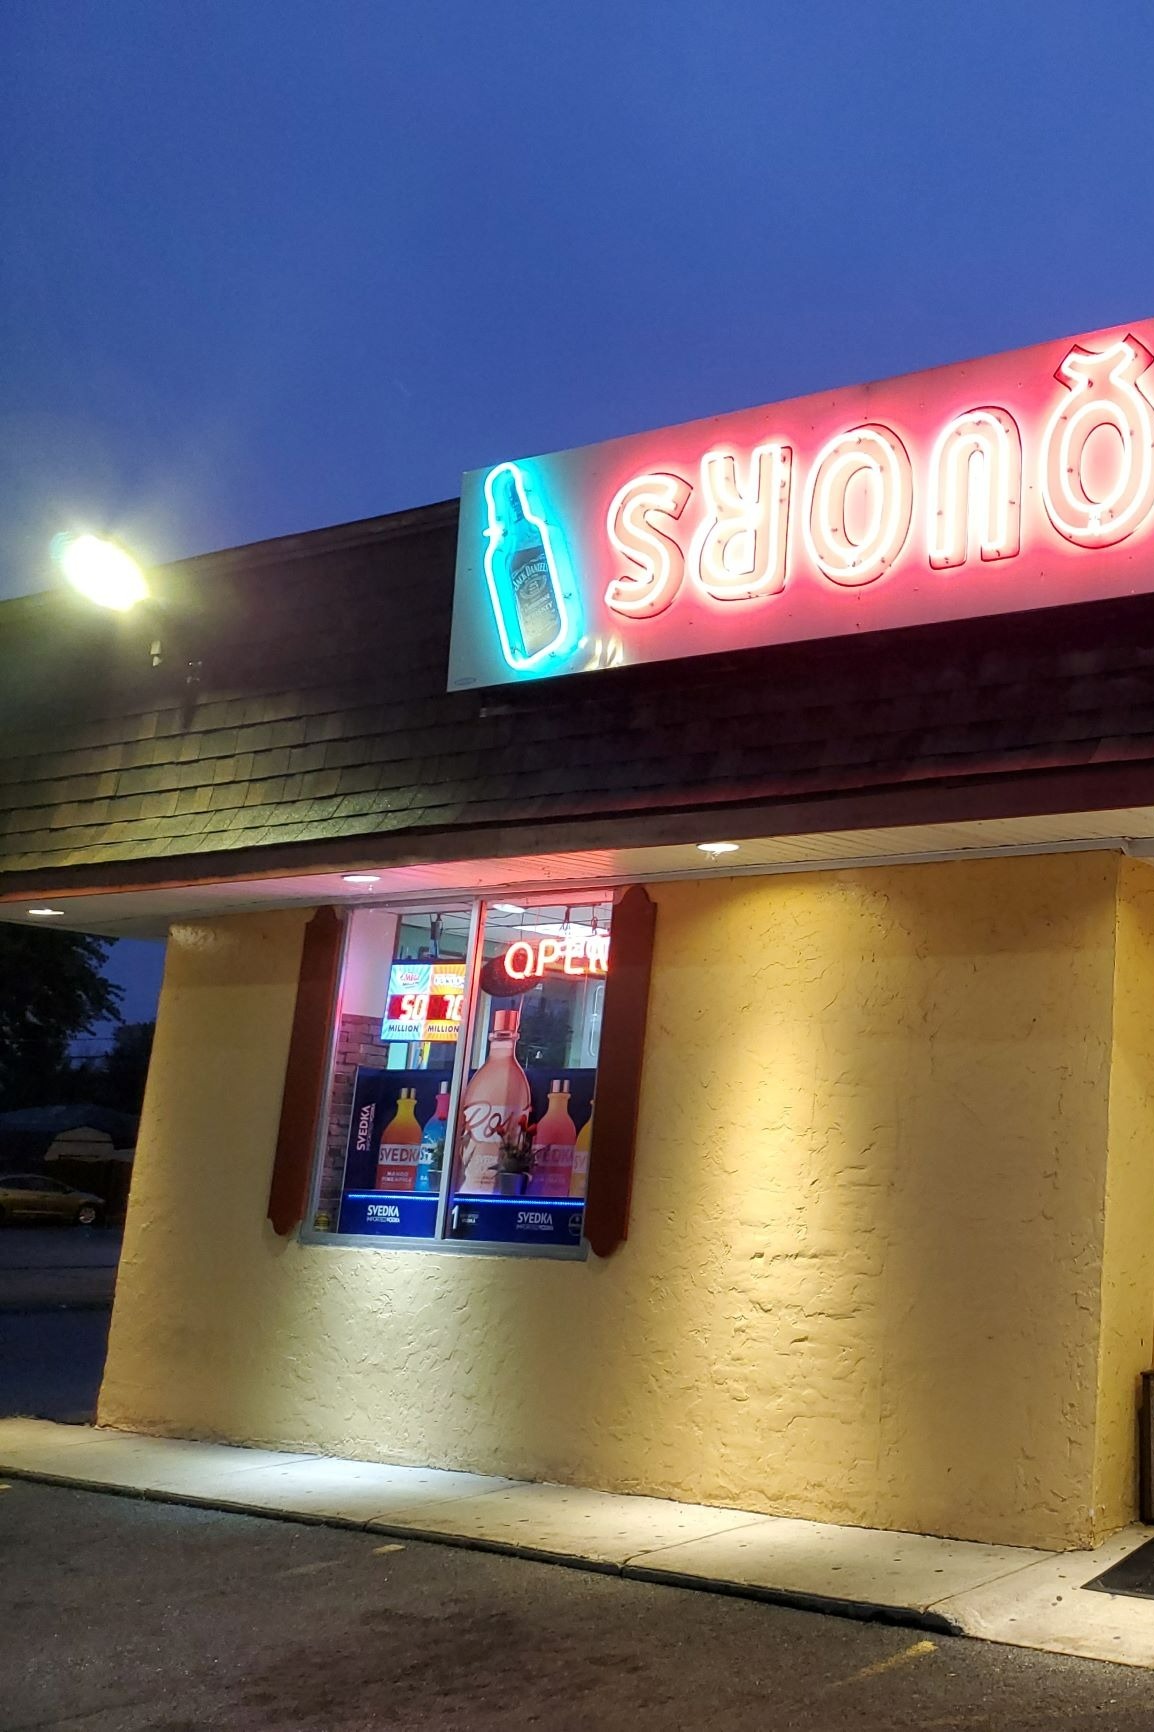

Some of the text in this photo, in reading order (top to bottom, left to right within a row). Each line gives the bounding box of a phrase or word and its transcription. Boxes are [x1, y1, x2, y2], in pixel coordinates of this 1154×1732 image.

[504, 937, 610, 980] OPEN
[399, 994, 427, 1021] 50
[388, 1024, 419, 1033] MILLION
[427, 1025, 460, 1033] MILLION
[356, 1104, 372, 1152] SVEDKA
[367, 1204, 399, 1217] SVEDKA
[517, 1211, 553, 1225] SVEDKA
